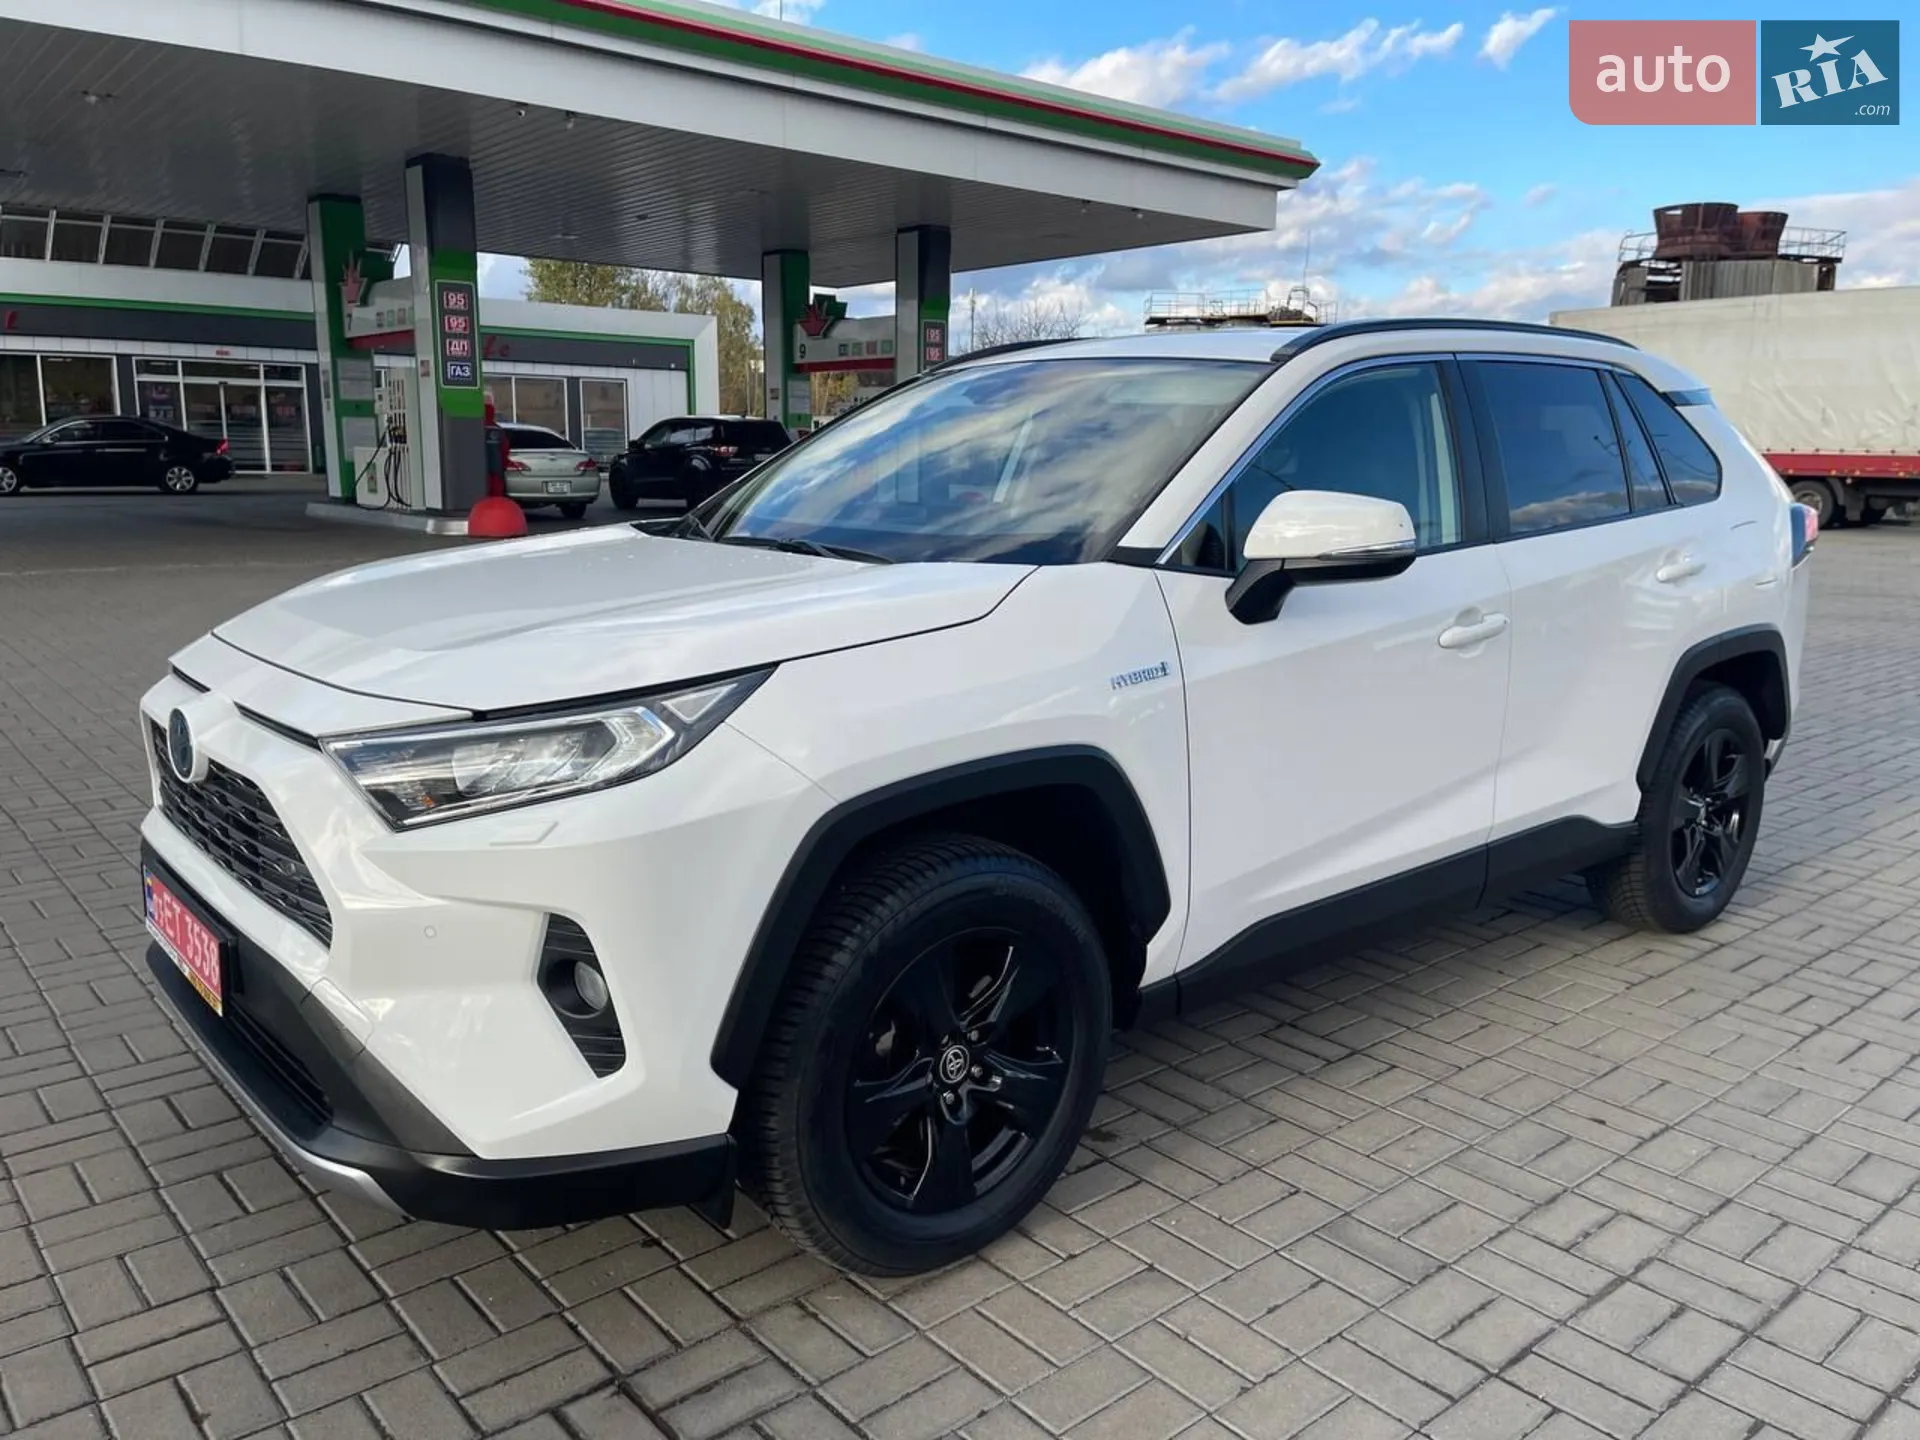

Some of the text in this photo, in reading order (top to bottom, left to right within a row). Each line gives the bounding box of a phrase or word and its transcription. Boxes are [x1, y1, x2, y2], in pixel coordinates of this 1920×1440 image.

[447, 292, 465, 305] 95
[450, 317, 466, 327] 95
[451, 340, 468, 351] ДП
[799, 344, 807, 359] 9
[450, 365, 471, 377] ГАЗ
